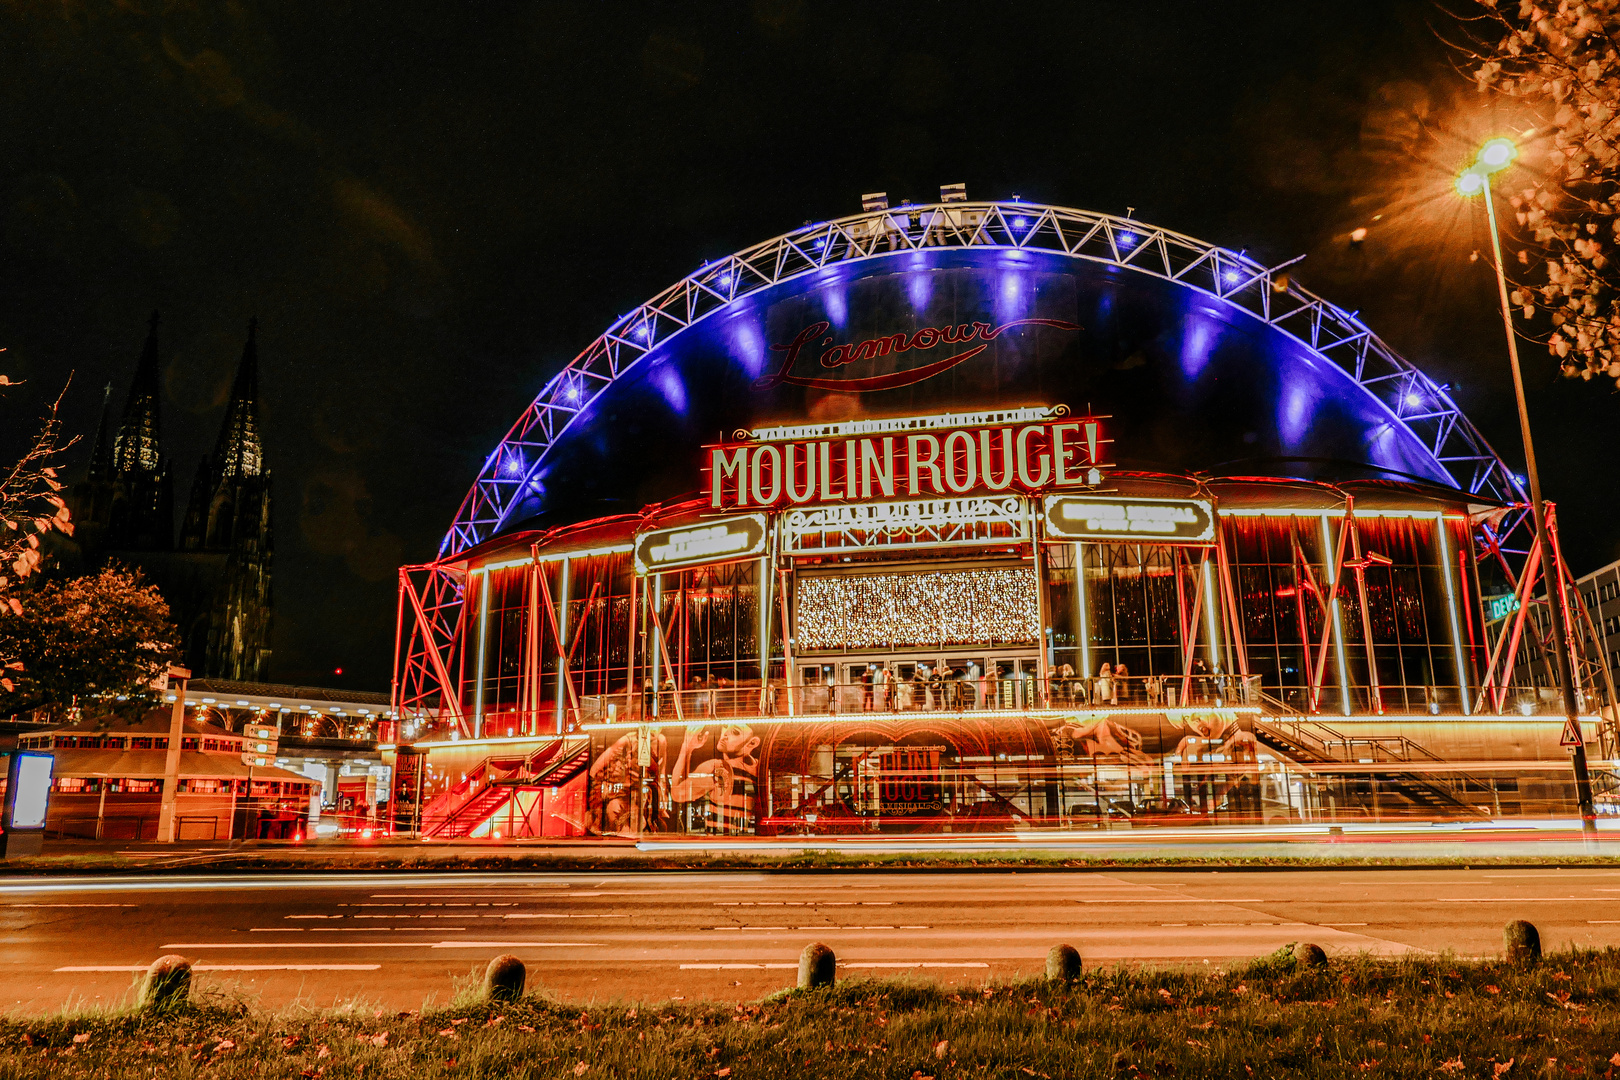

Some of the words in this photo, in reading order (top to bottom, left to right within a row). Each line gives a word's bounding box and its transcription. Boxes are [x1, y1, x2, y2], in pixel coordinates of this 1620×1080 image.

[751, 318, 1083, 392] L'amour
[712, 437, 895, 508] MOULIN
[907, 422, 1101, 496] ROUGE!
